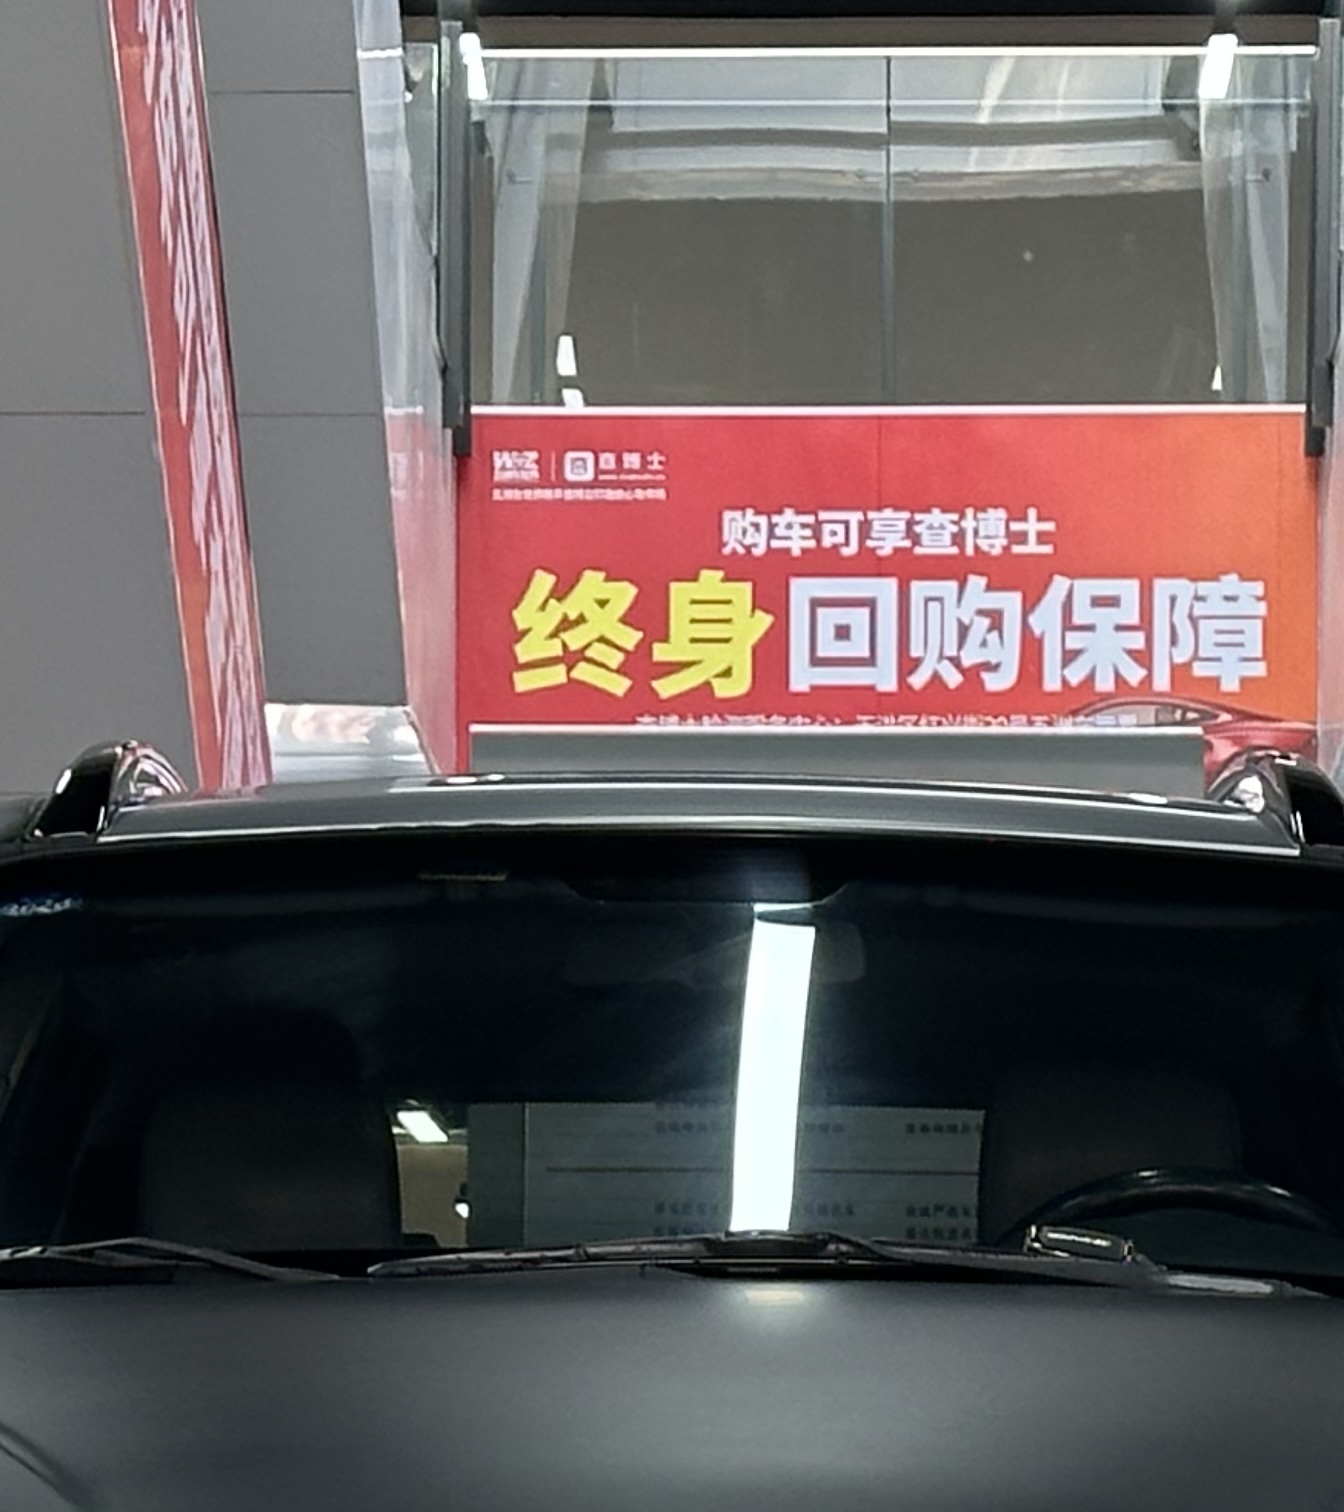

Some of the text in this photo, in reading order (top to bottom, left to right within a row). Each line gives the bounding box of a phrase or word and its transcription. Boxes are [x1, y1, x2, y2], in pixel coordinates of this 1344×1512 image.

[720, 507, 1056, 557] 购车可享查博士
